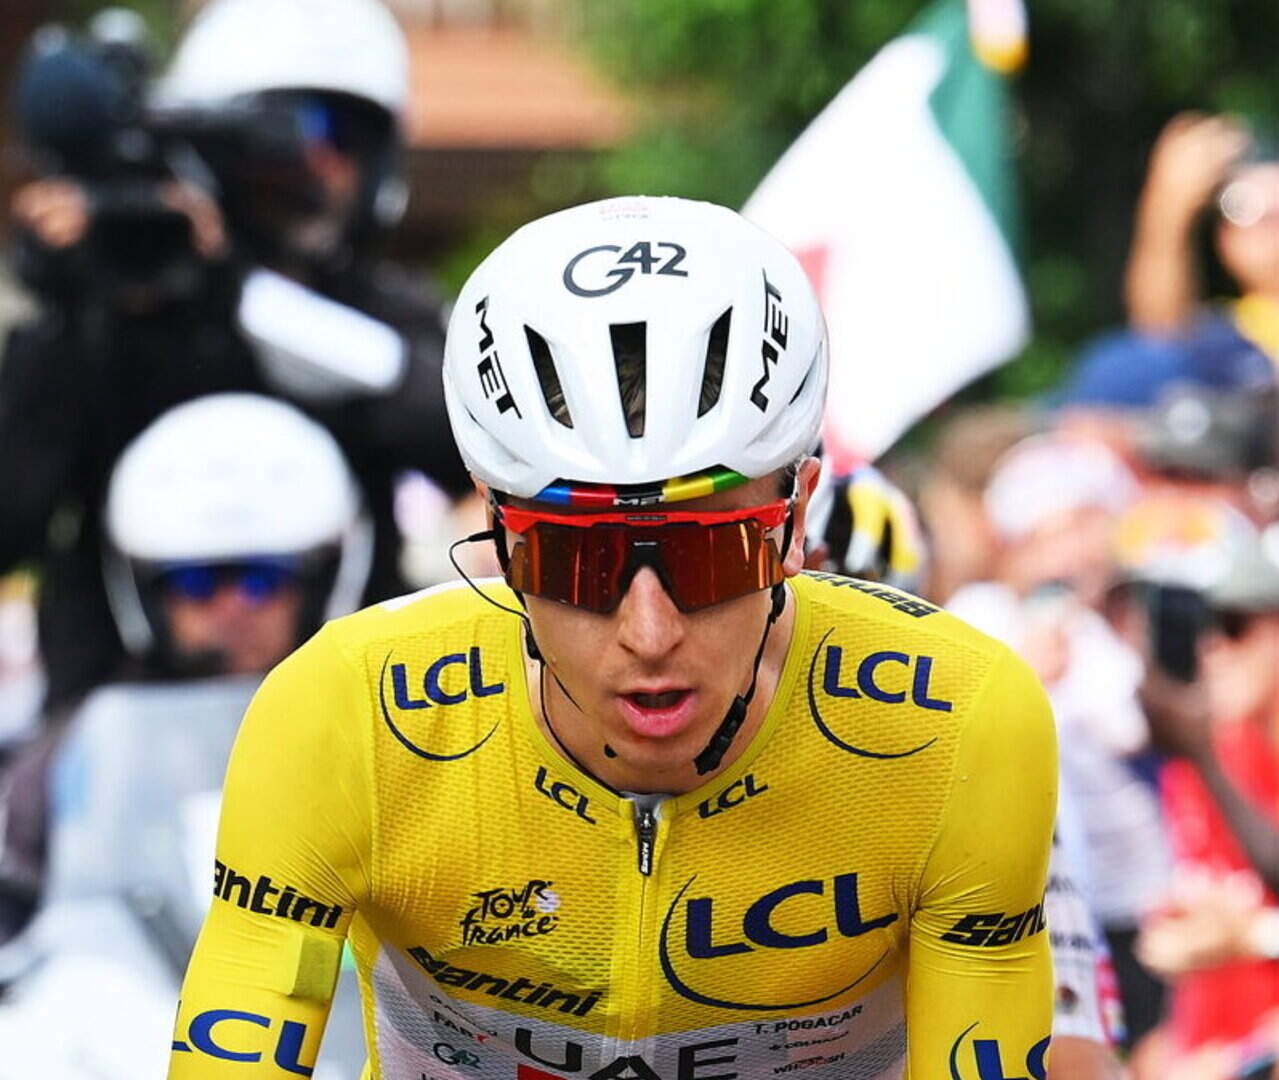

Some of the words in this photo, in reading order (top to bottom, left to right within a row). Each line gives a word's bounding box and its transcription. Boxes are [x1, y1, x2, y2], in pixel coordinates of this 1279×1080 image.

[563, 242, 689, 298] G42
[476, 296, 523, 420] MET
[750, 267, 789, 413] MET
[391, 646, 505, 711] LCL
[822, 645, 953, 713] LCL
[534, 766, 596, 824] LCL
[698, 773, 768, 819] LCL
[214, 858, 344, 929] antini
[686, 873, 899, 960] LCL
